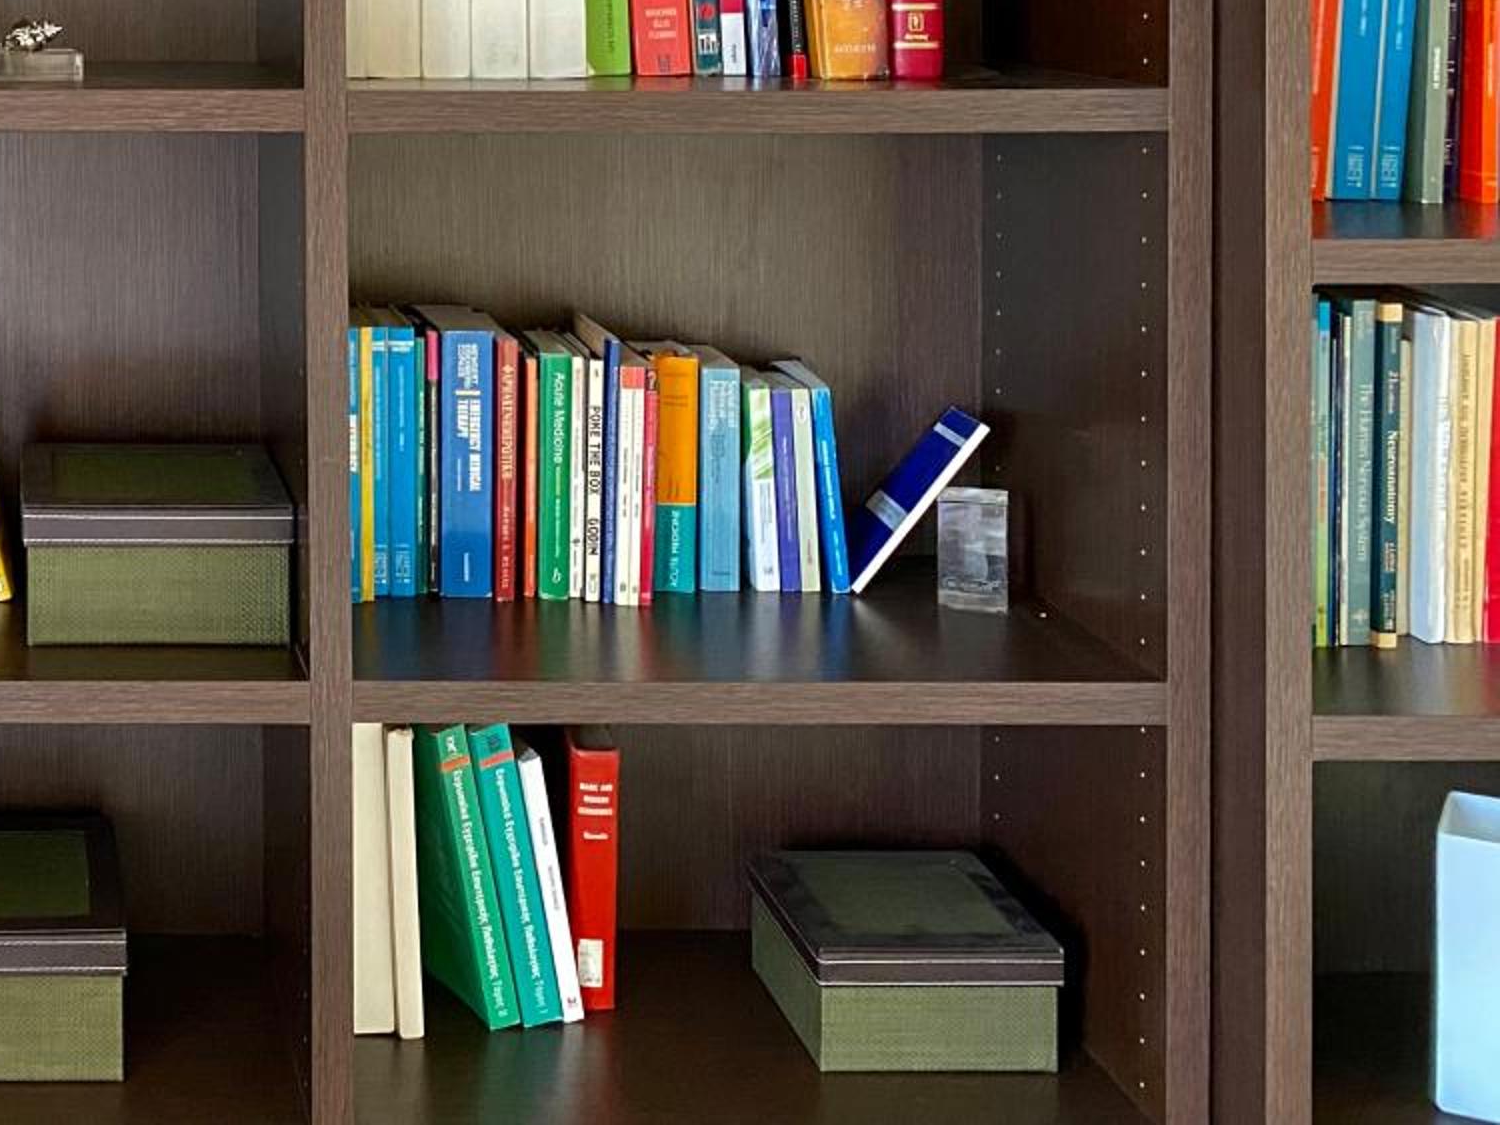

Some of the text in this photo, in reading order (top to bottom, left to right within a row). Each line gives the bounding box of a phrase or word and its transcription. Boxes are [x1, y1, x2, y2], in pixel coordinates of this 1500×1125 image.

[553, 372, 566, 464] Acute Medicine
[587, 405, 601, 556] POKE THE BOX GODIN
[1383, 429, 1399, 525] Neuroanatomy
